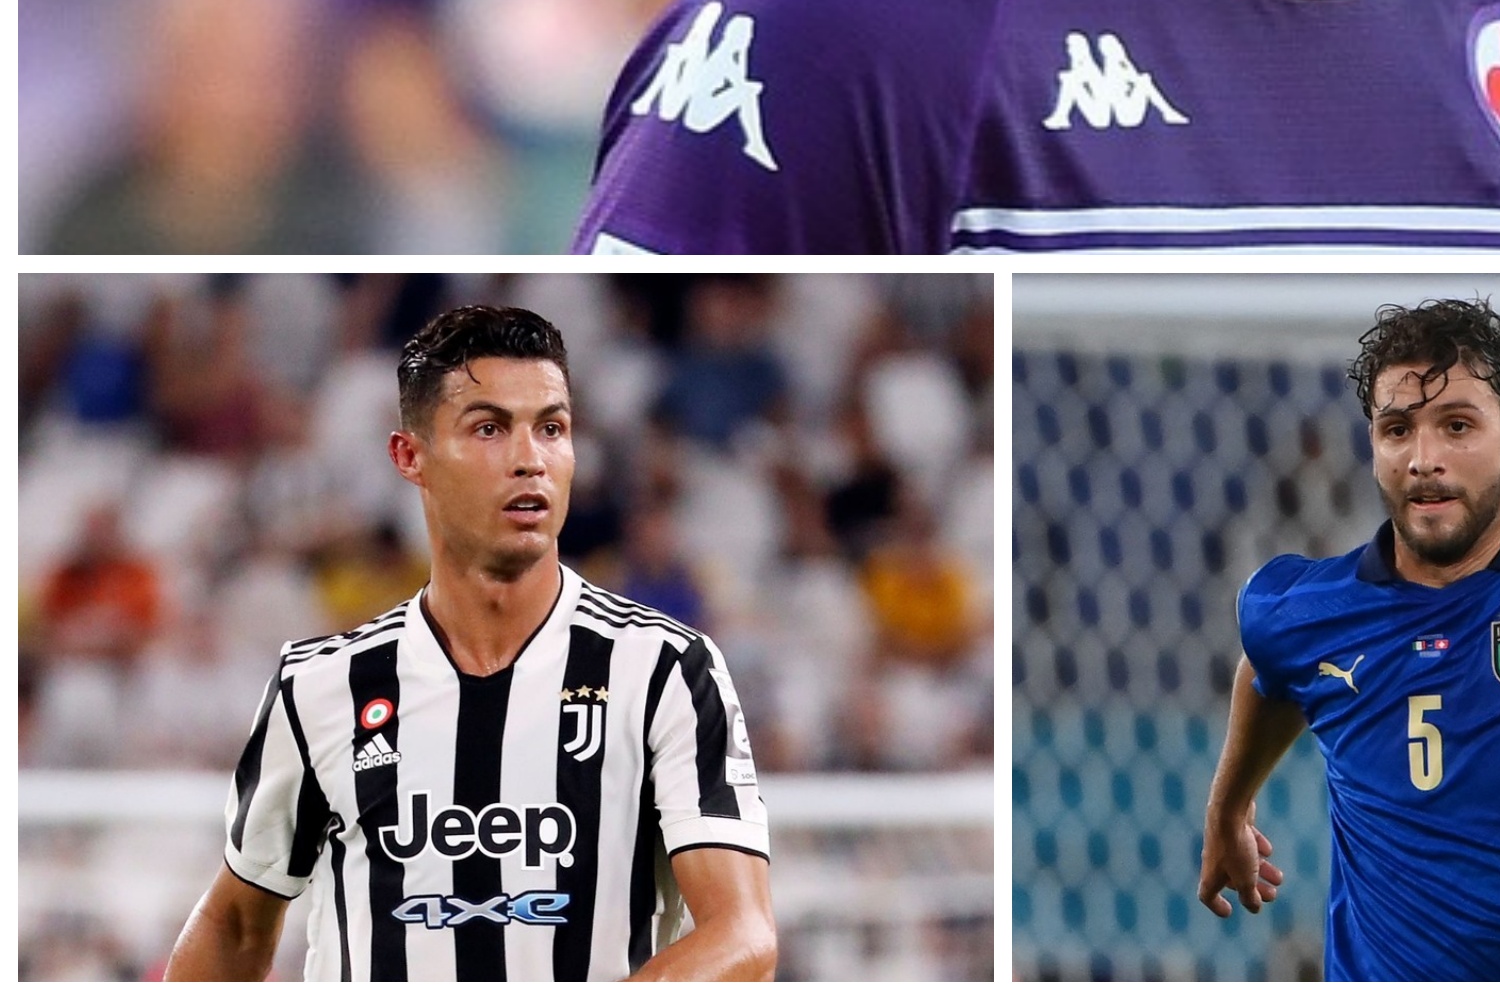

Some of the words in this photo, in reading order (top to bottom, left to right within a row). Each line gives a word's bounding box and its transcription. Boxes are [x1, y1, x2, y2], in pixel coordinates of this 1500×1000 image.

[352, 750, 401, 772] adidas
[1408, 694, 1443, 791] 5
[380, 790, 576, 869] Jeep
